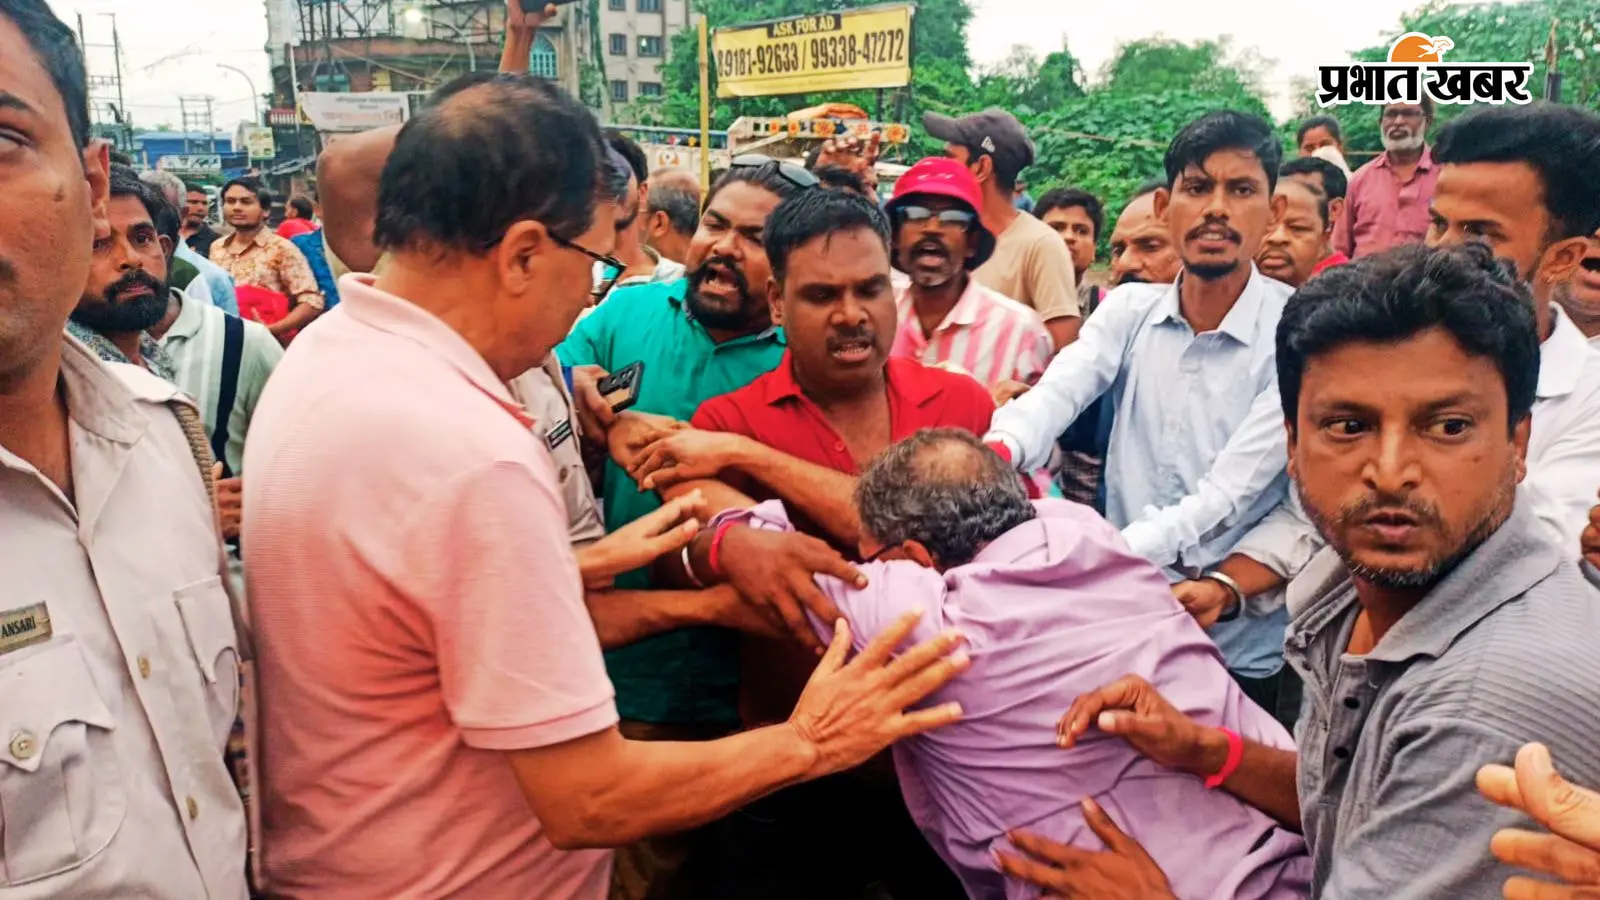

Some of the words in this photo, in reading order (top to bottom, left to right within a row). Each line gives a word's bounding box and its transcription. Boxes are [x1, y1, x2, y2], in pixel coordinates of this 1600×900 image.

[773, 21, 795, 37] ASK
[796, 18, 818, 34] FOR
[819, 15, 835, 31] AD
[810, 28, 904, 69] 99338-47272
[1, 615, 36, 638] ANSARI
